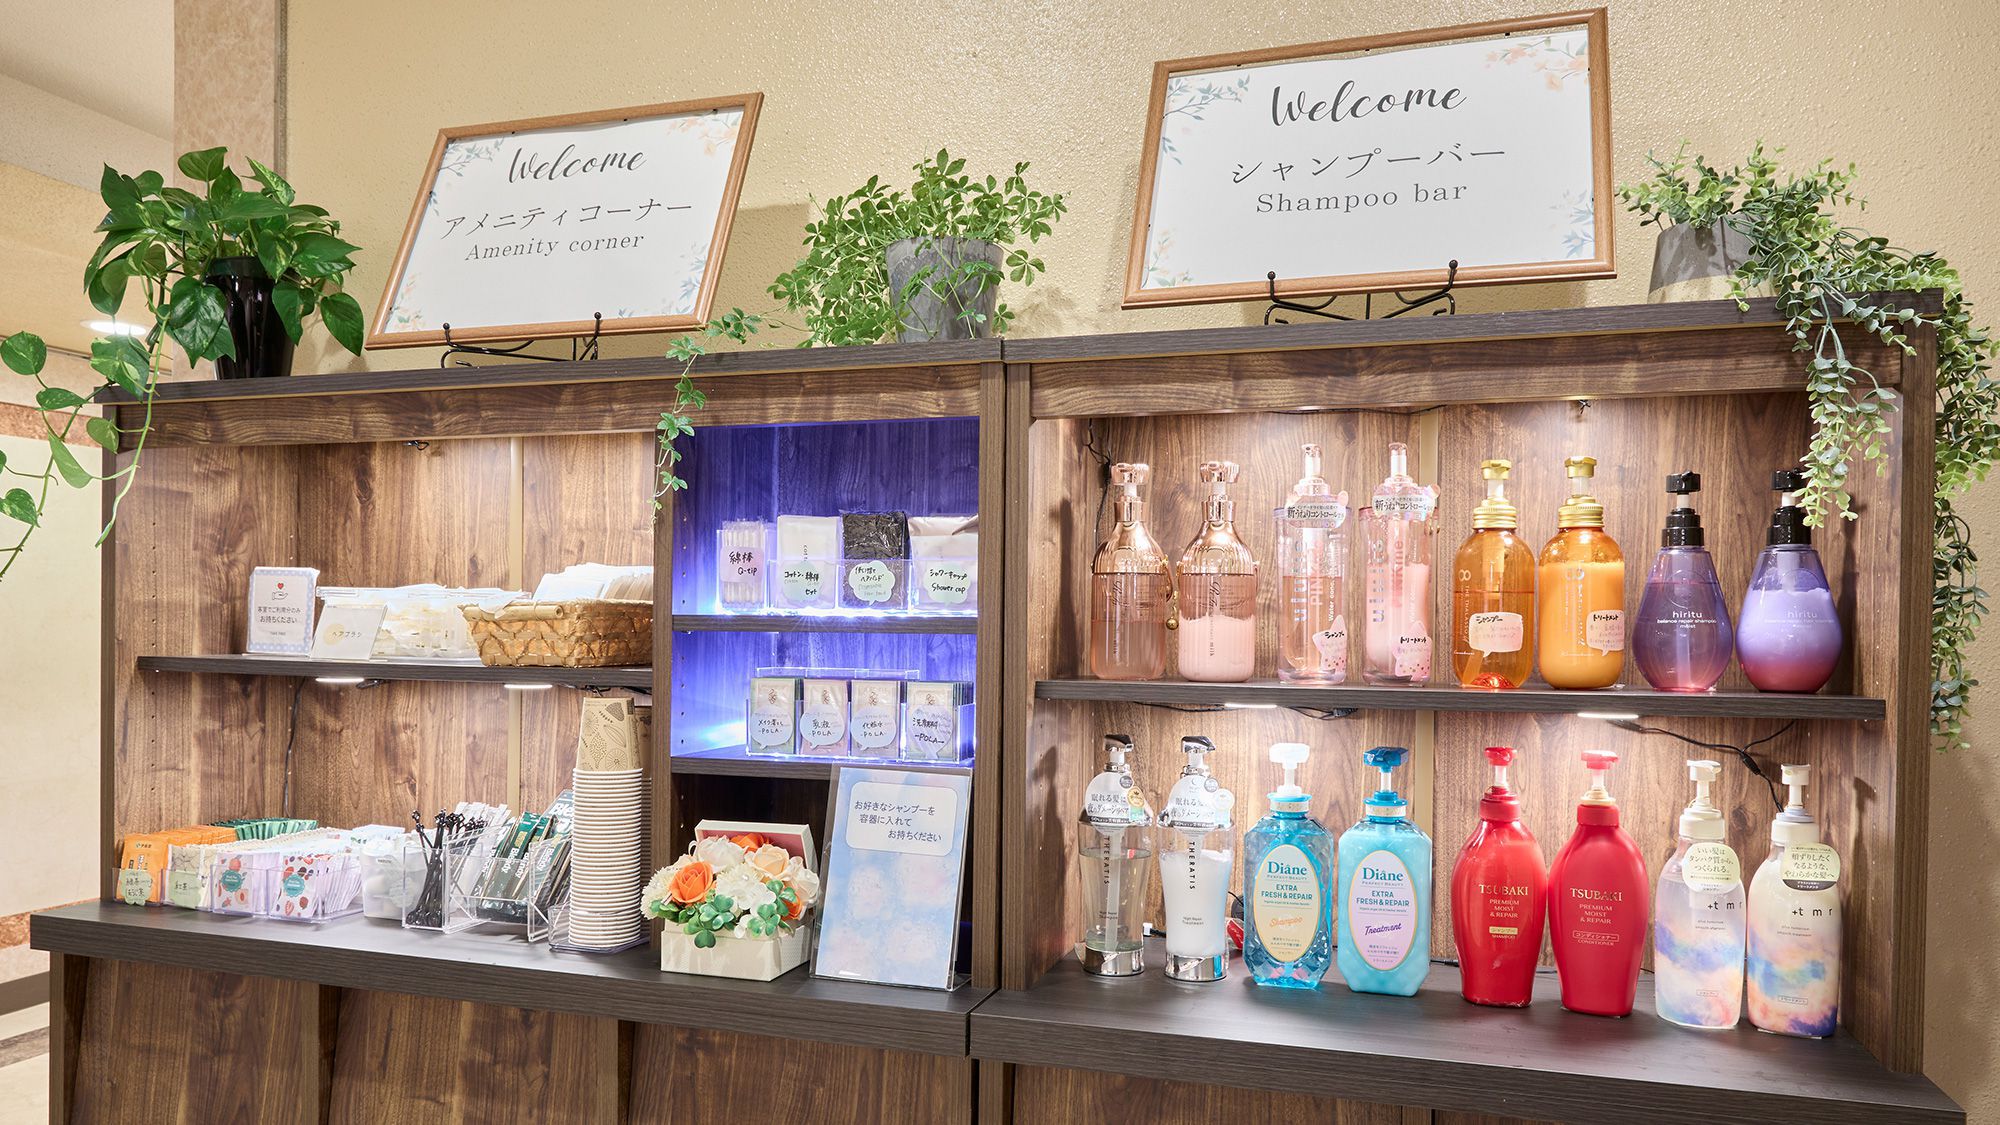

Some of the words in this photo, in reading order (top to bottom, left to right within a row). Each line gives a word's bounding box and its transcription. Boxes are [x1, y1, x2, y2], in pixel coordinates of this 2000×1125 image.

[1271, 80, 1467, 127] Welcome
[508, 144, 647, 184] Welcome
[1232, 143, 1505, 185] シャンプーバー
[1256, 190, 1399, 214] Shampoo
[1414, 183, 1468, 204] bar
[441, 197, 693, 240] アメニティコーナー
[465, 237, 560, 261] Amenity
[569, 233, 645, 253] corner
[930, 569, 967, 580] シャワーキャップ
[931, 583, 953, 592] Shower
[1672, 610, 1703, 619] hiritu
[854, 800, 936, 816] お好きなシャンプーを
[859, 814, 913, 827] 容器に入れて
[888, 829, 942, 842] お持ちください
[1103, 837, 1111, 885] THERATIS
[1188, 841, 1196, 890] THERATIS
[1267, 861, 1308, 875] Diâne
[1362, 867, 1404, 881] Diâne
[1371, 890, 1394, 898] EXTRA
[1479, 884, 1529, 896] TSUBAKI
[1570, 887, 1623, 902] TSUBAKI
[1579, 903, 1613, 911] PREMIUM
[1365, 923, 1402, 936] Treatment
